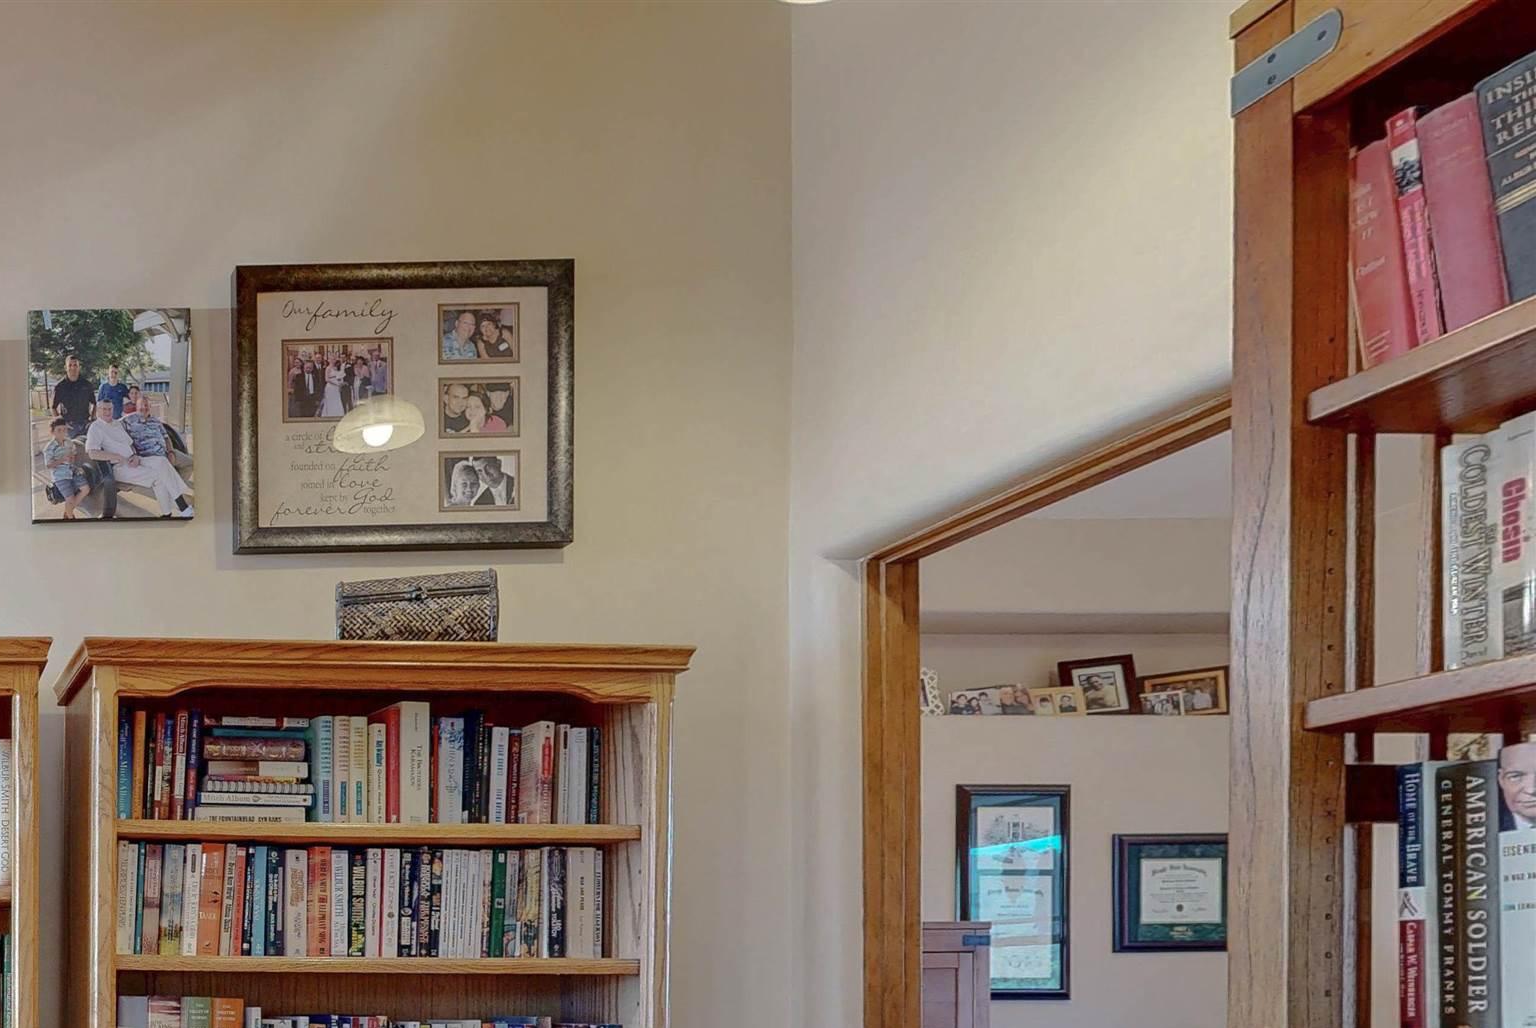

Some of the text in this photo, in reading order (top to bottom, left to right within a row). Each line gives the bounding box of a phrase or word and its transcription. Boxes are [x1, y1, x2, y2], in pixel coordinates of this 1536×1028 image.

[281, 298, 398, 334] Our family
[291, 455, 390, 482] founded on faith
[300, 472, 382, 491] joined in love
[270, 502, 395, 526] forever together
[320, 487, 394, 514] kept by God
[1501, 478, 1528, 563] Chosin
[1459, 444, 1493, 645] COLDEST WINTER
[335, 865, 344, 917] WILBUR SMITH
[352, 866, 363, 922] WILBUR SMITH
[1441, 779, 1456, 1015] GENERAL TOMMY FRANKS
[1464, 776, 1487, 1015] AMERICAN SOLDIER
